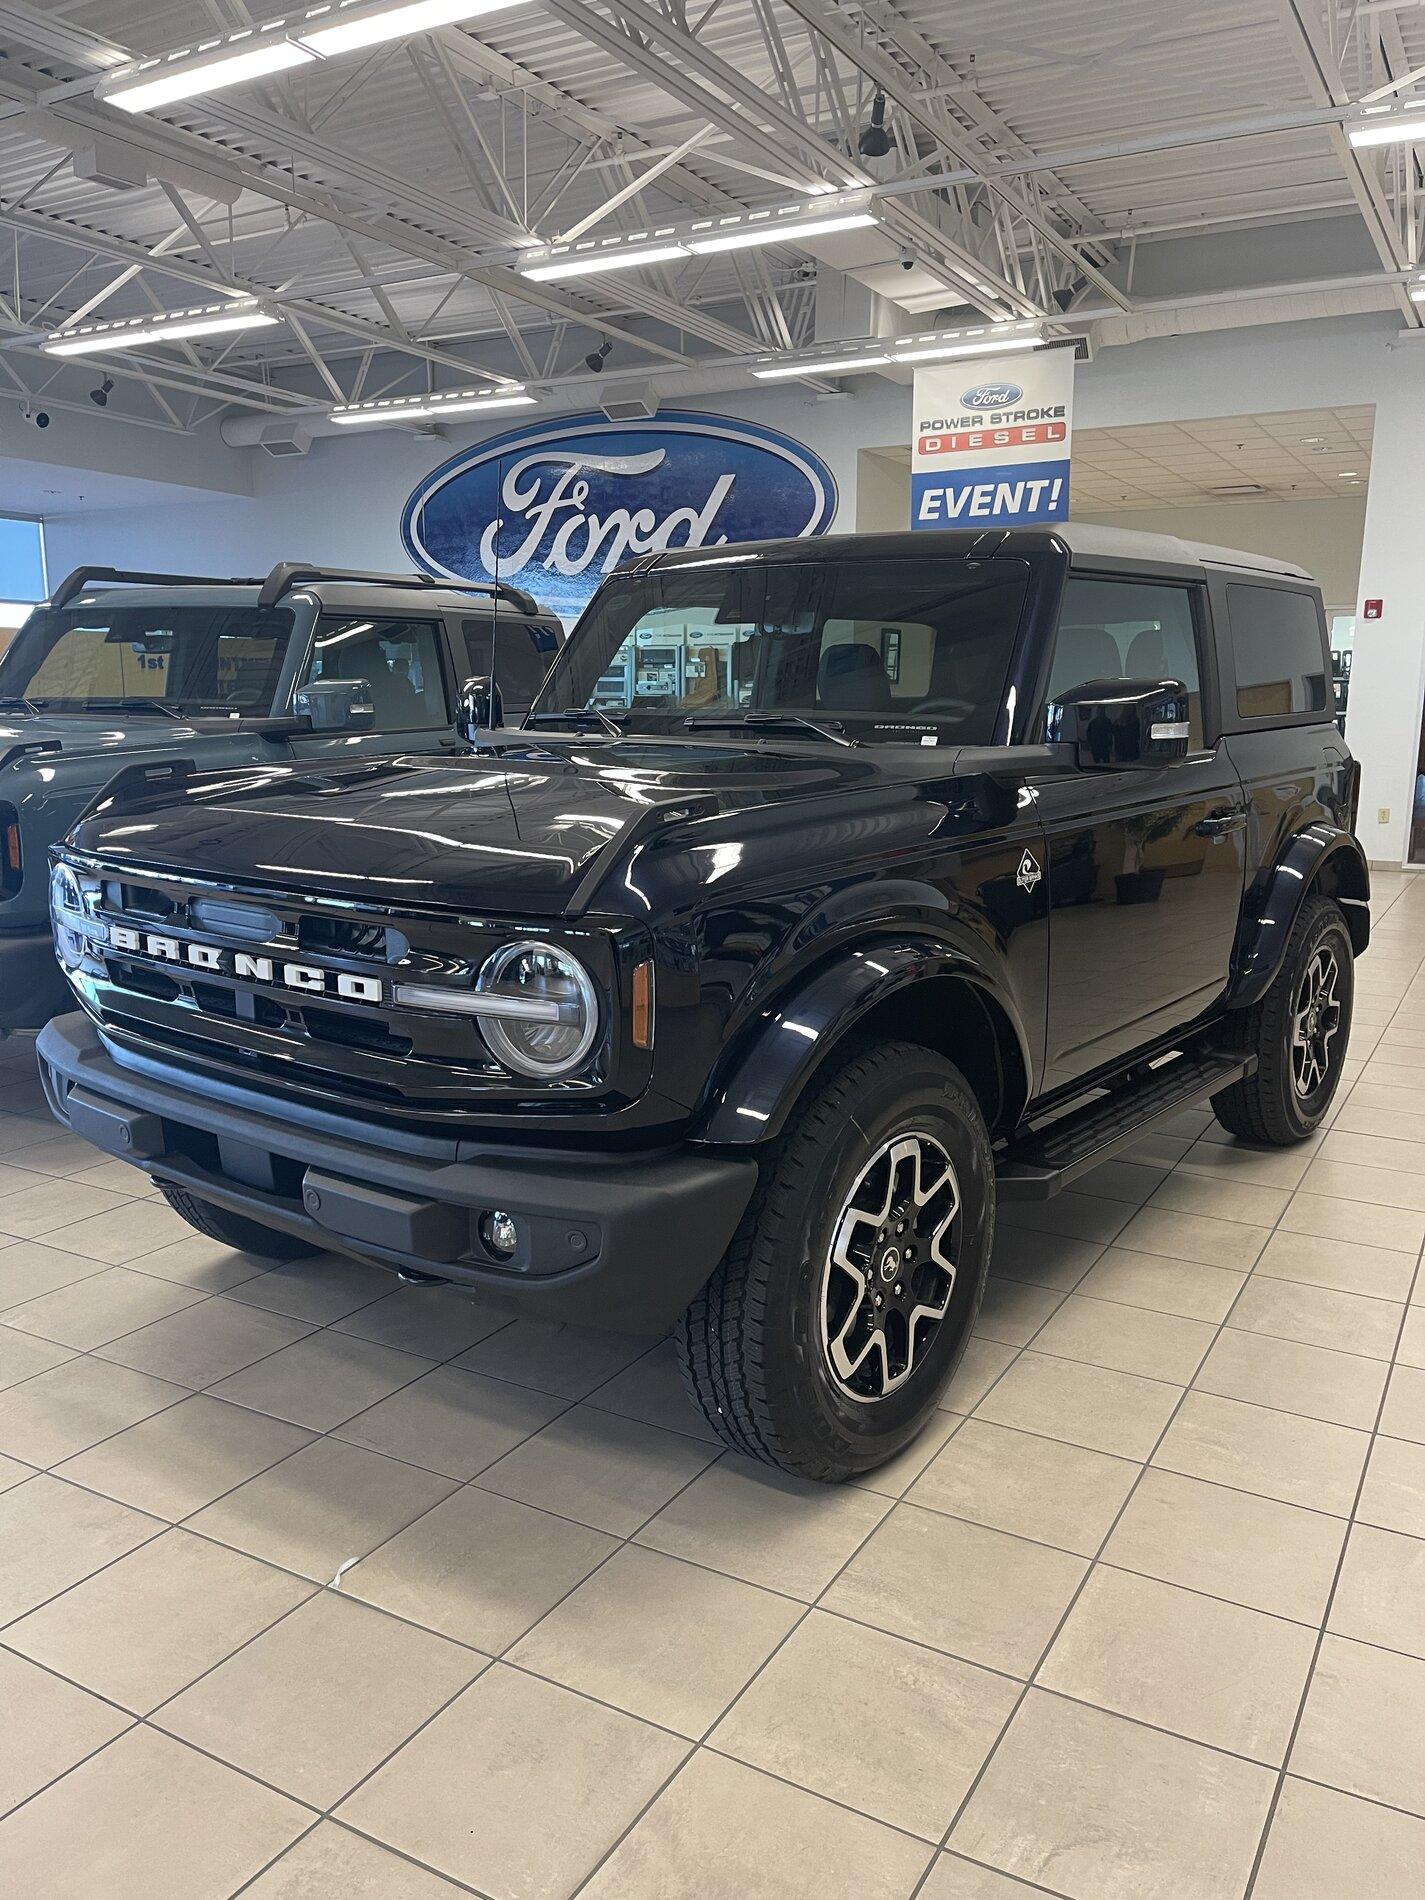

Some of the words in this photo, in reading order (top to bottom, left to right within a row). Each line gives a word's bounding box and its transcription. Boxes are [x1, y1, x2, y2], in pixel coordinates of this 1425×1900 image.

[972, 387, 1010, 406] Ford
[920, 415, 983, 432] POWER
[990, 405, 1066, 425] STROKE
[925, 427, 1060, 451] DIESEL
[918, 478, 1063, 520] EVENT!
[479, 448, 736, 578] Ford
[137, 655, 165, 670] 1st
[110, 926, 382, 1003] BRONCO
